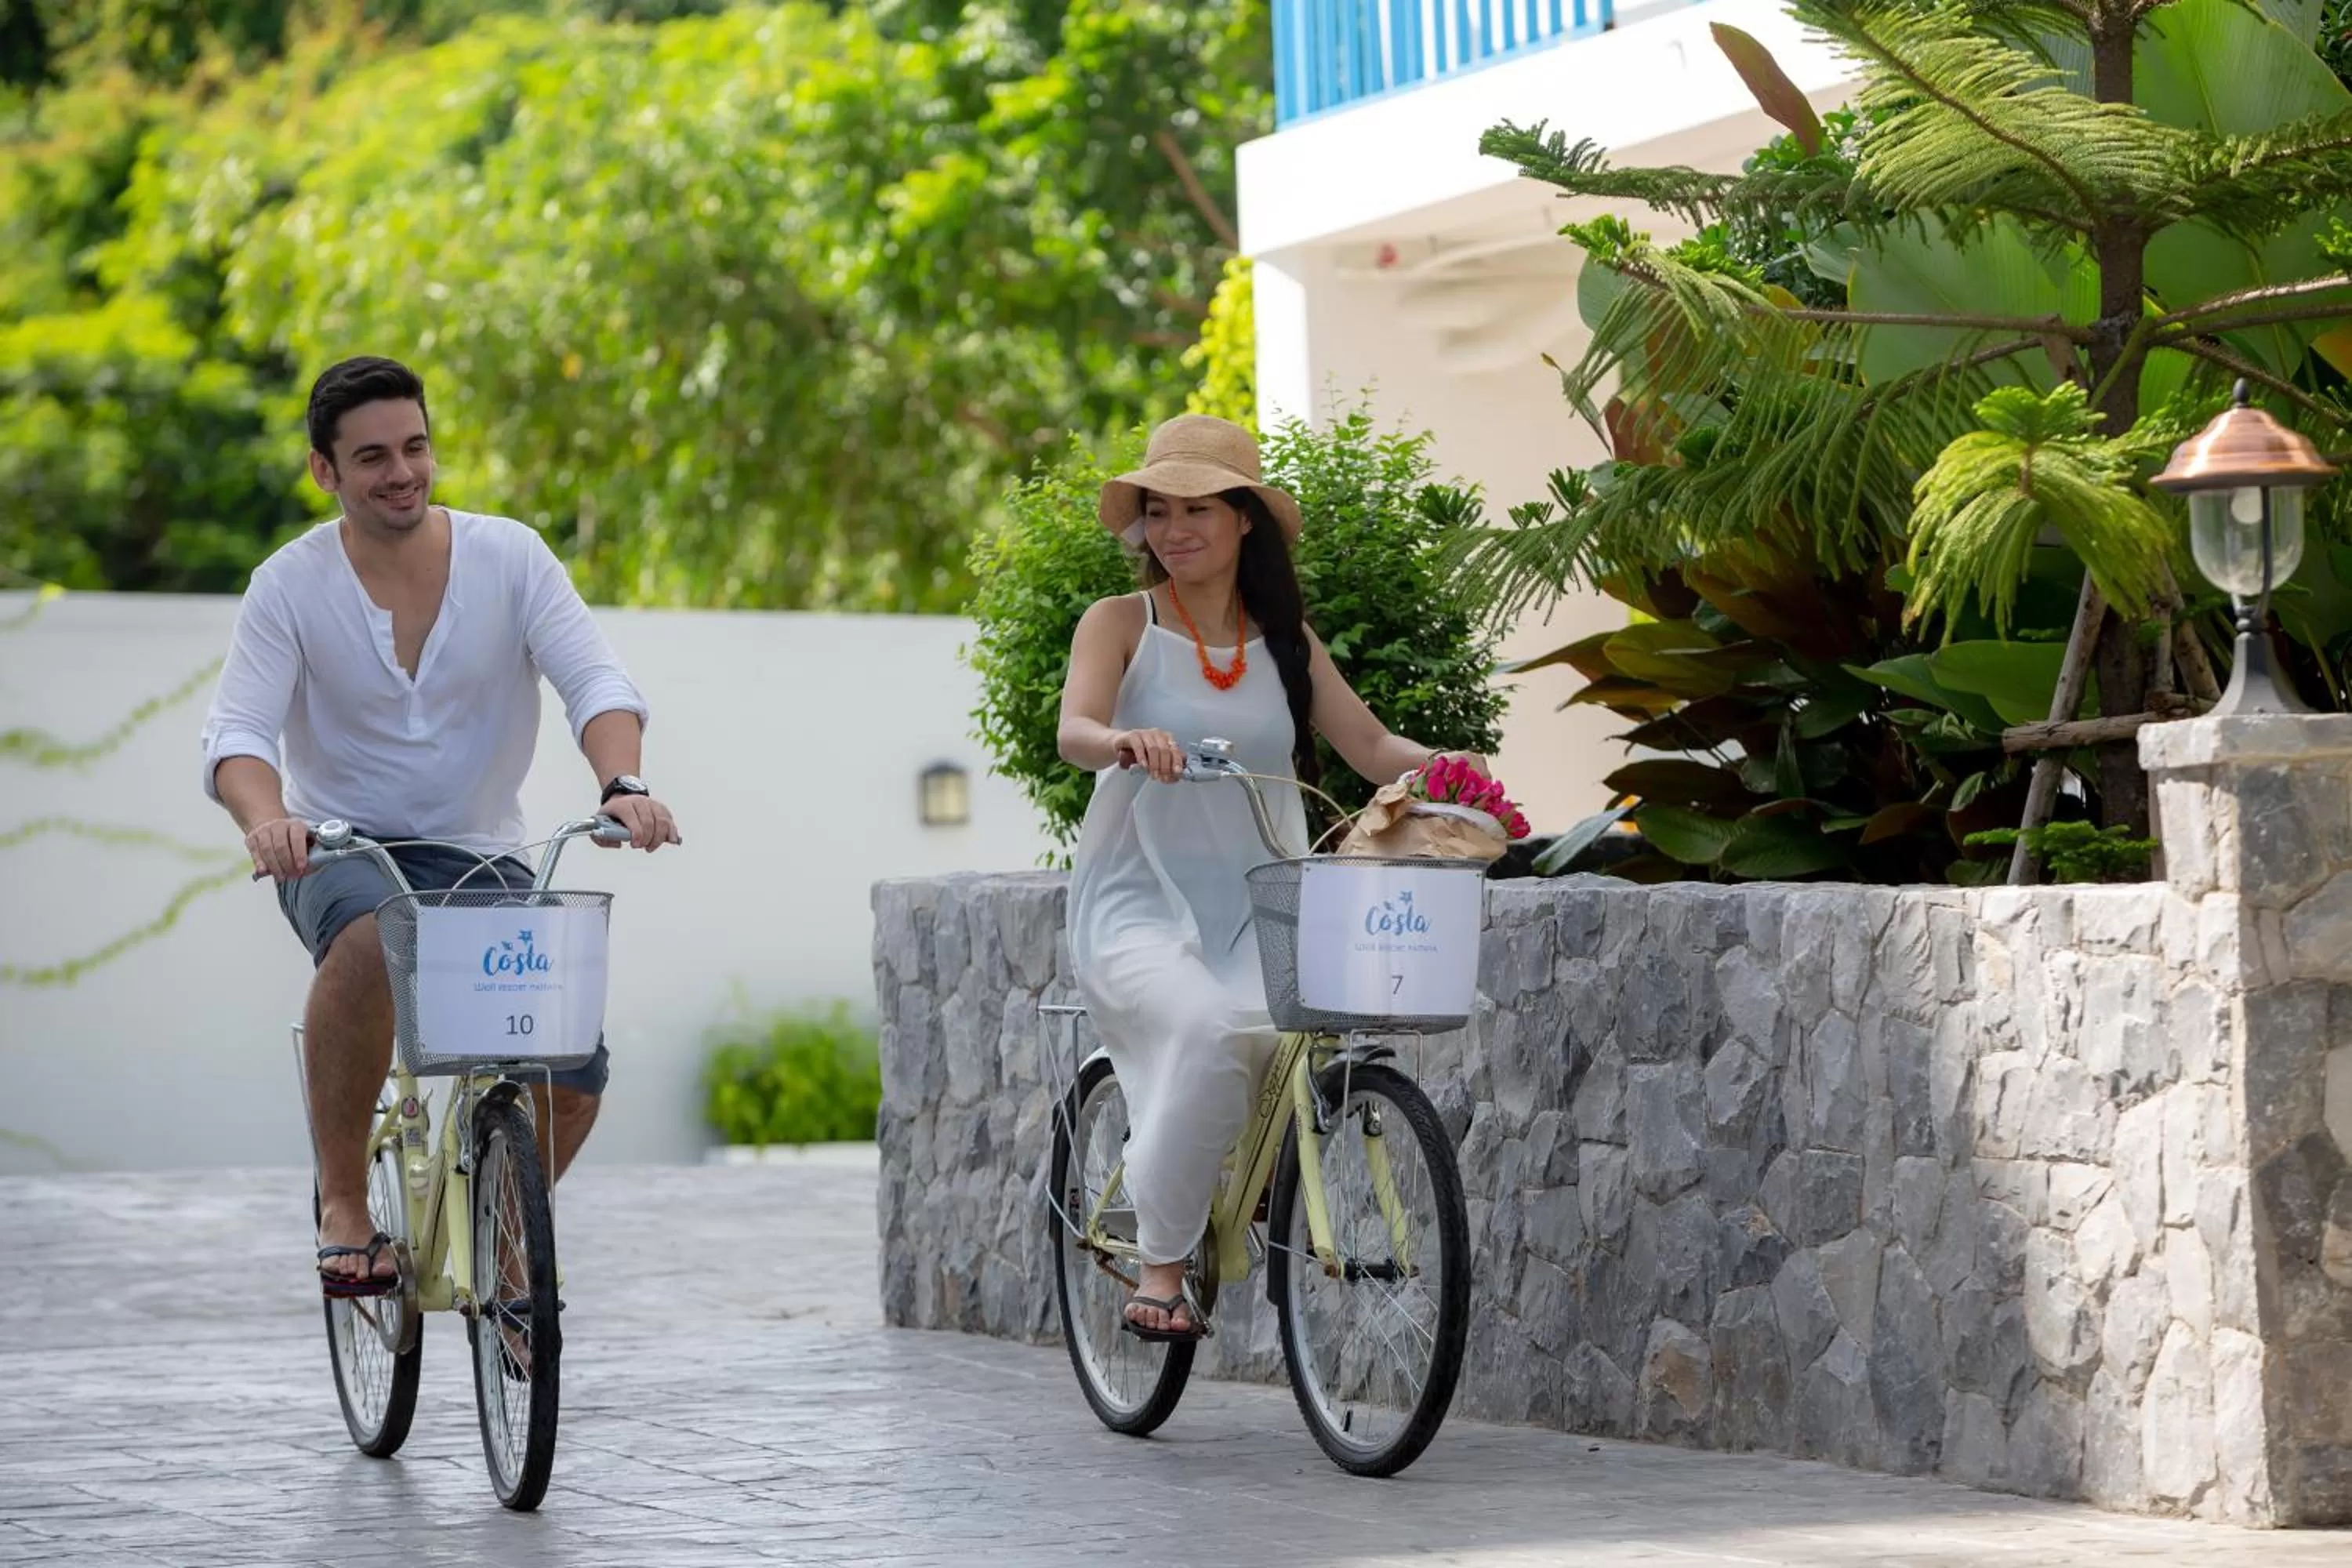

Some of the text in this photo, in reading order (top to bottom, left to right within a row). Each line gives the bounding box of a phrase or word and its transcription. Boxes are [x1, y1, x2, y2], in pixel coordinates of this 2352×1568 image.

[1366, 906, 1430, 935] Costa
[483, 943, 554, 976] Costa
[1392, 975, 1403, 995] 7
[506, 1014, 534, 1035] 10
